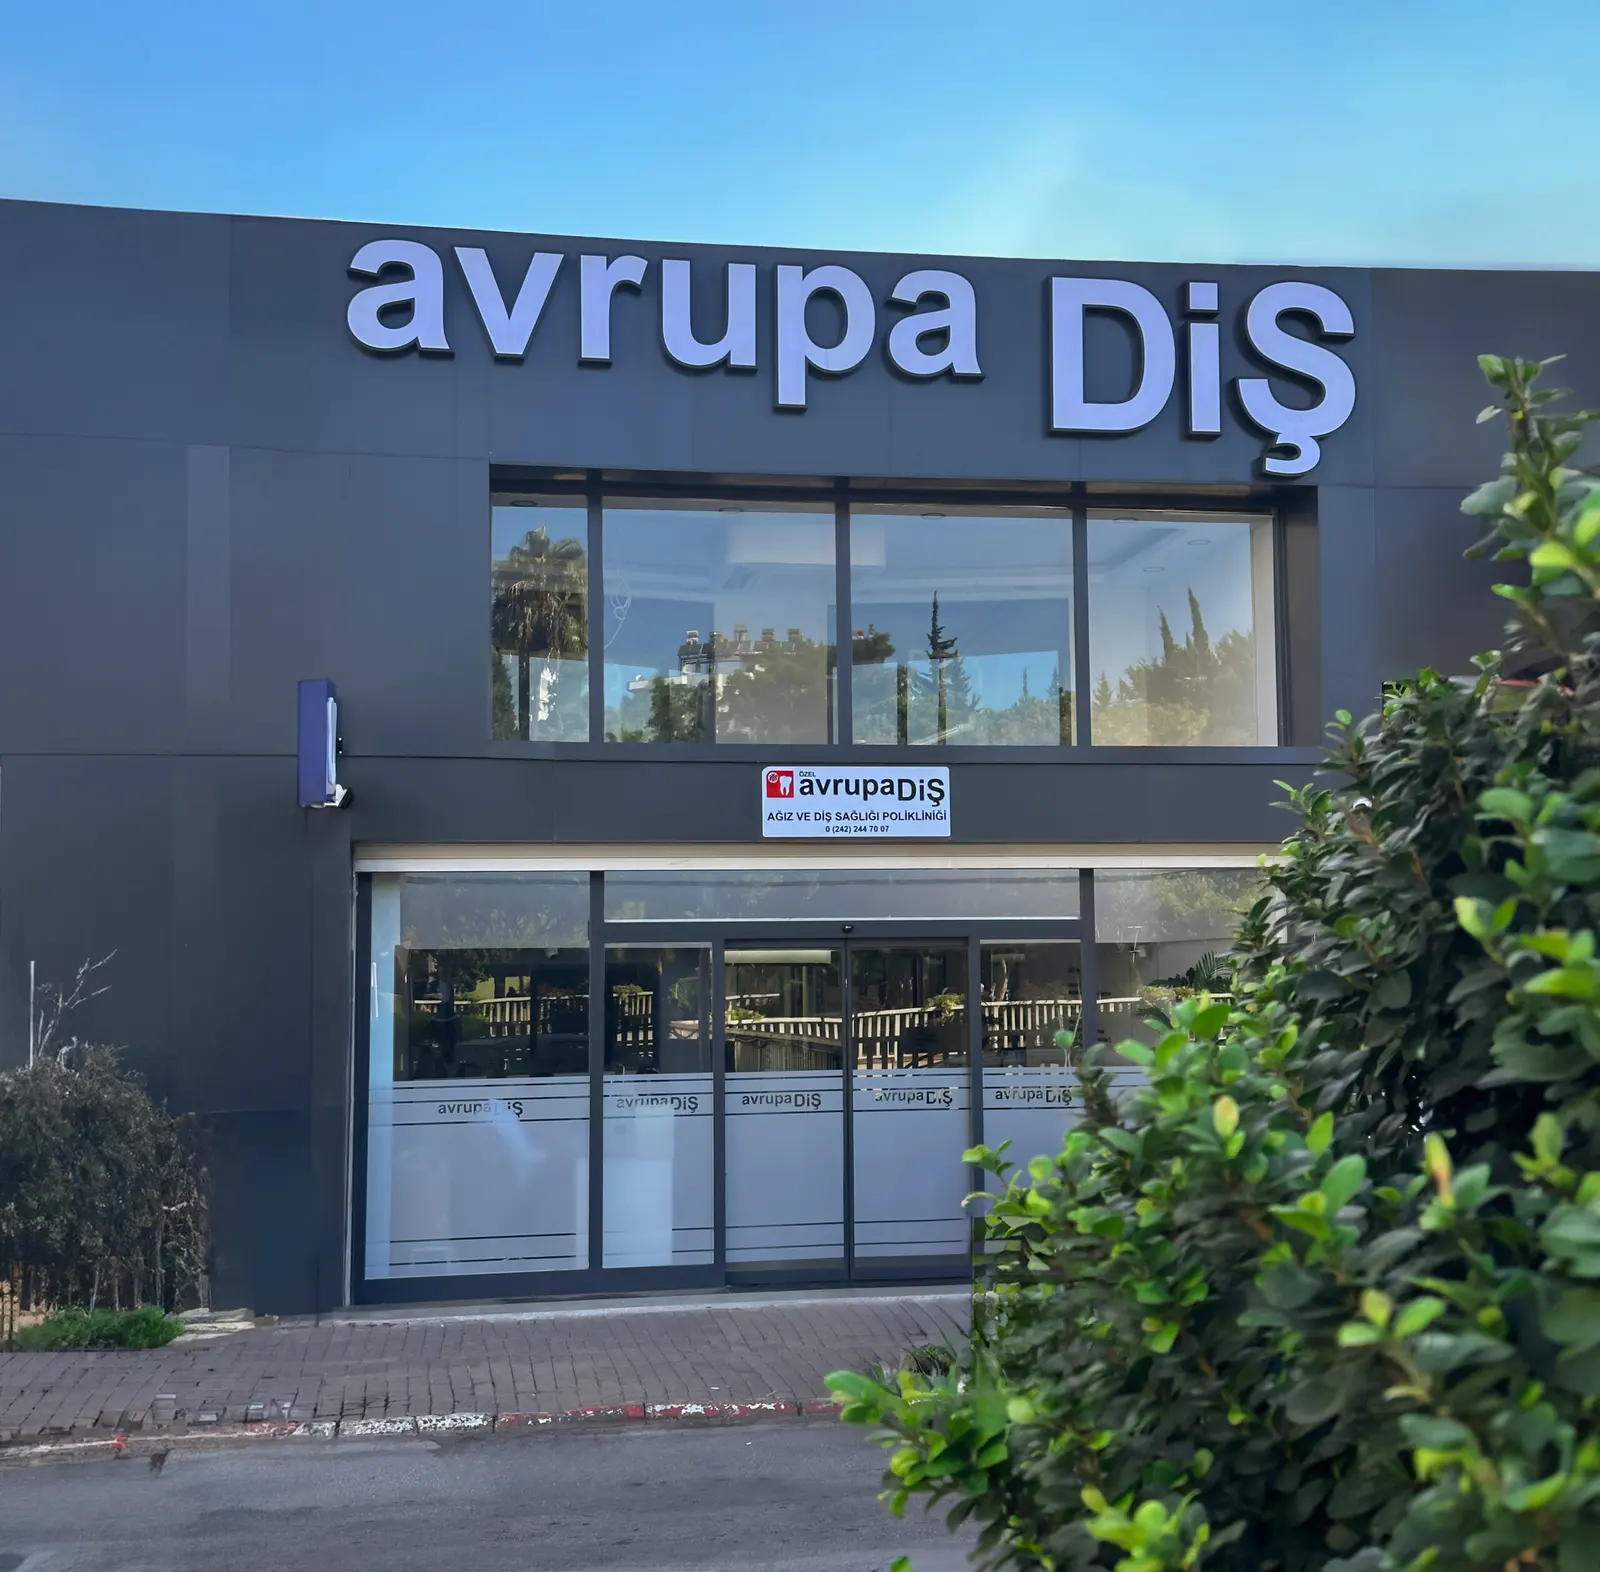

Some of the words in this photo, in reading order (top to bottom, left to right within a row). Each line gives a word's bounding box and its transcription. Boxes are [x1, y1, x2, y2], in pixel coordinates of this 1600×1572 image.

[346, 238, 985, 415] avrupa
[767, 810, 794, 821] AĞIZ
[796, 812, 811, 821] VE
[814, 810, 832, 823] DİŞ
[835, 810, 880, 821] SAĞLIĞI
[882, 810, 947, 821] POLİKLİNİĞİ
[832, 825, 852, 834] (242)
